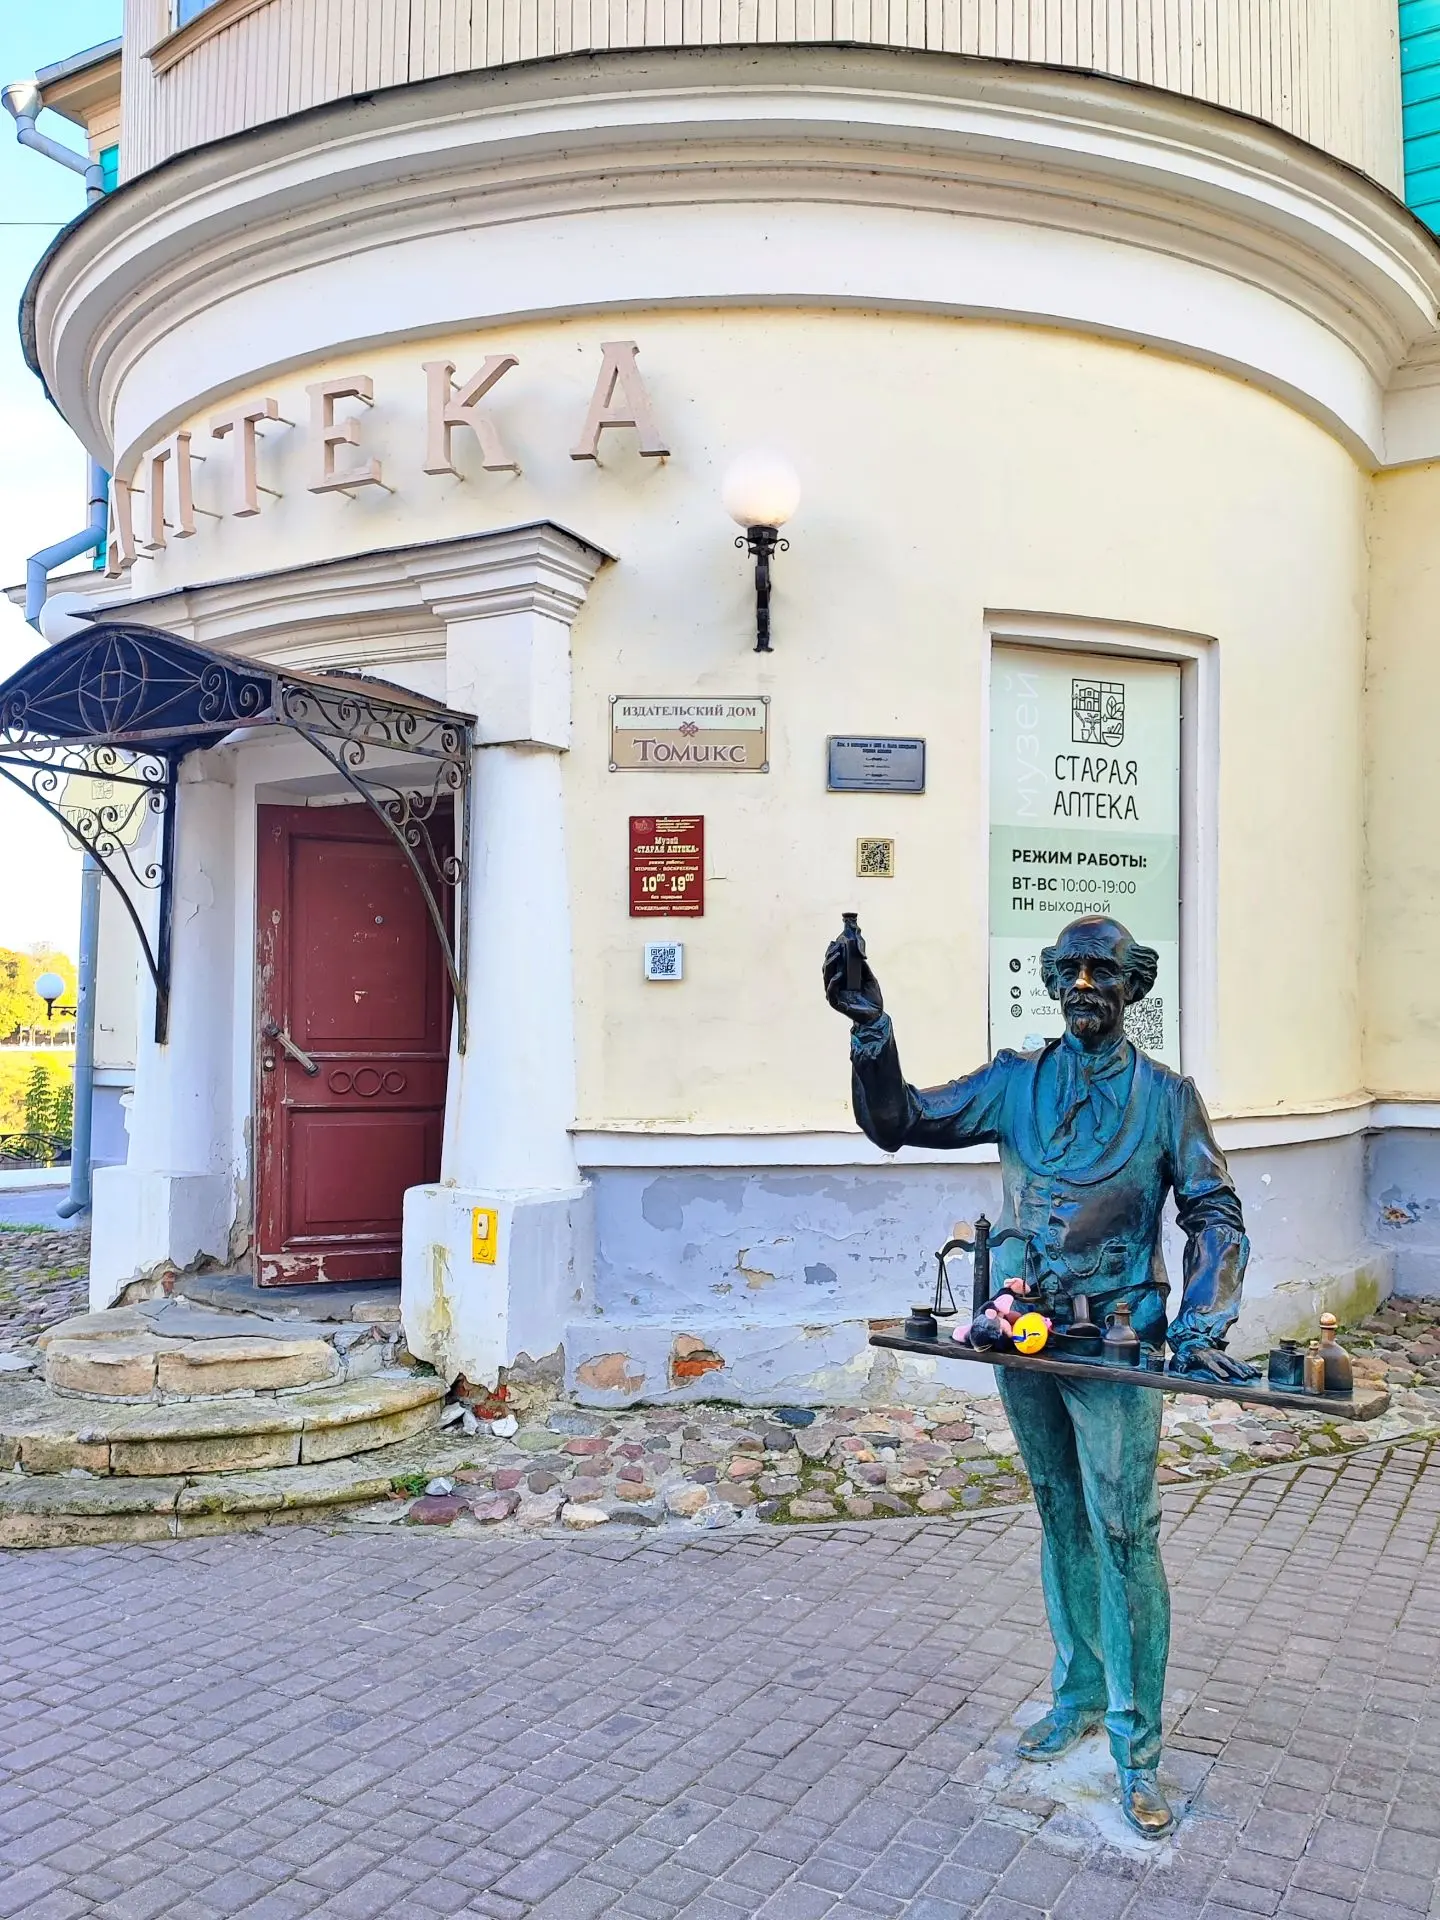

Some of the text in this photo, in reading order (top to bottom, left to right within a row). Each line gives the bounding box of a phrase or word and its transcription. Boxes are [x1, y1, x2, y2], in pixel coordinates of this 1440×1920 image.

[104, 340, 671, 579] АПТЕКА
[622, 703, 756, 718] ИЗДАТЕЛЬСКИЙ ДОМ
[1055, 755, 1138, 786] СТАРАЯ
[1053, 790, 1139, 821] АПТЕКА
[1012, 849, 1147, 868] РЕЖИМ РАБОТЫ:
[1012, 876, 1136, 894] ВТ-ВС 10:00-19:00
[1012, 897, 1111, 914] ПН выходной
[1029, 987, 1048, 997] vk.c
